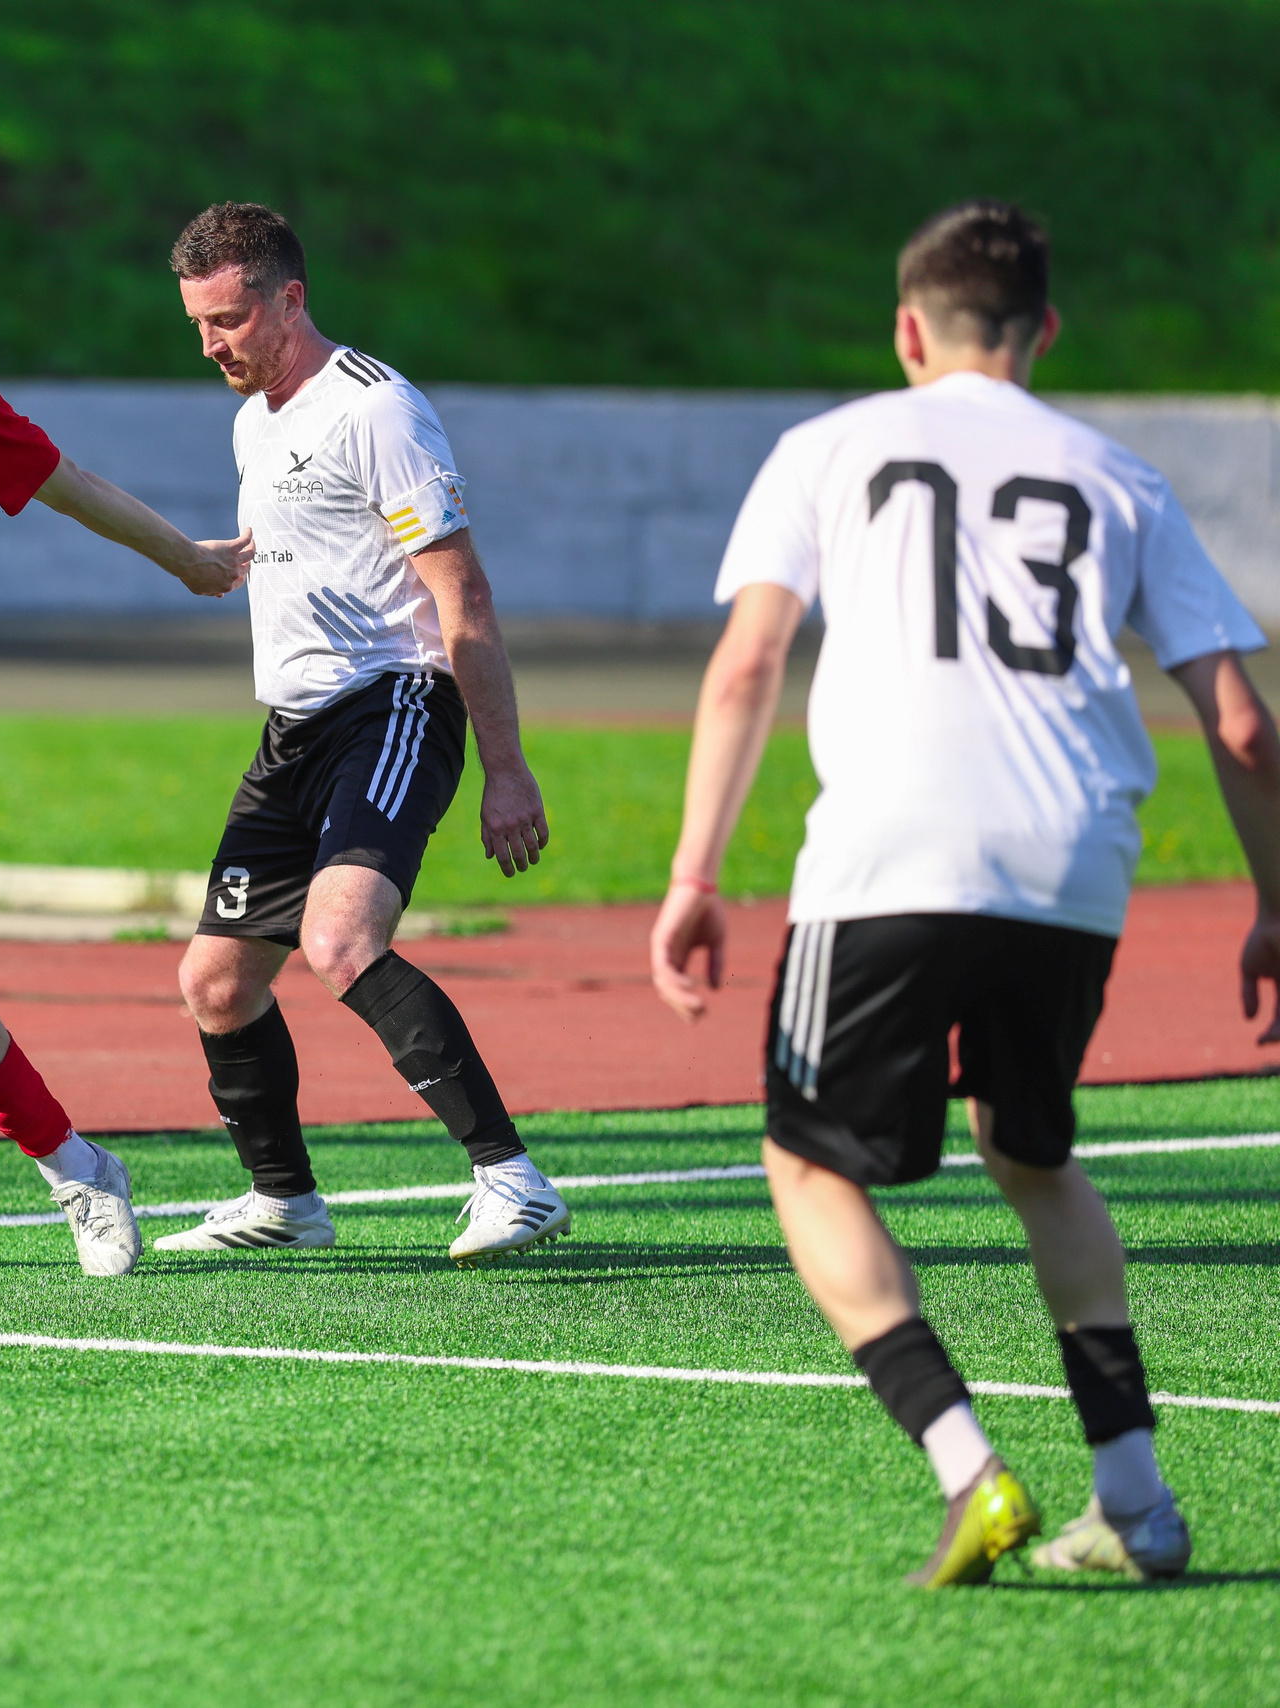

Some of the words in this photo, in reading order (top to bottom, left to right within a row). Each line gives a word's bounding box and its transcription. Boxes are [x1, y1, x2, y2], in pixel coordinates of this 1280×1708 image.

[272, 477, 324, 494] ЧАЙКА
[277, 495, 313, 503] САМАРА
[270, 549, 293, 563] Tab
[867, 460, 1092, 676] 13
[216, 866, 250, 919] 3
